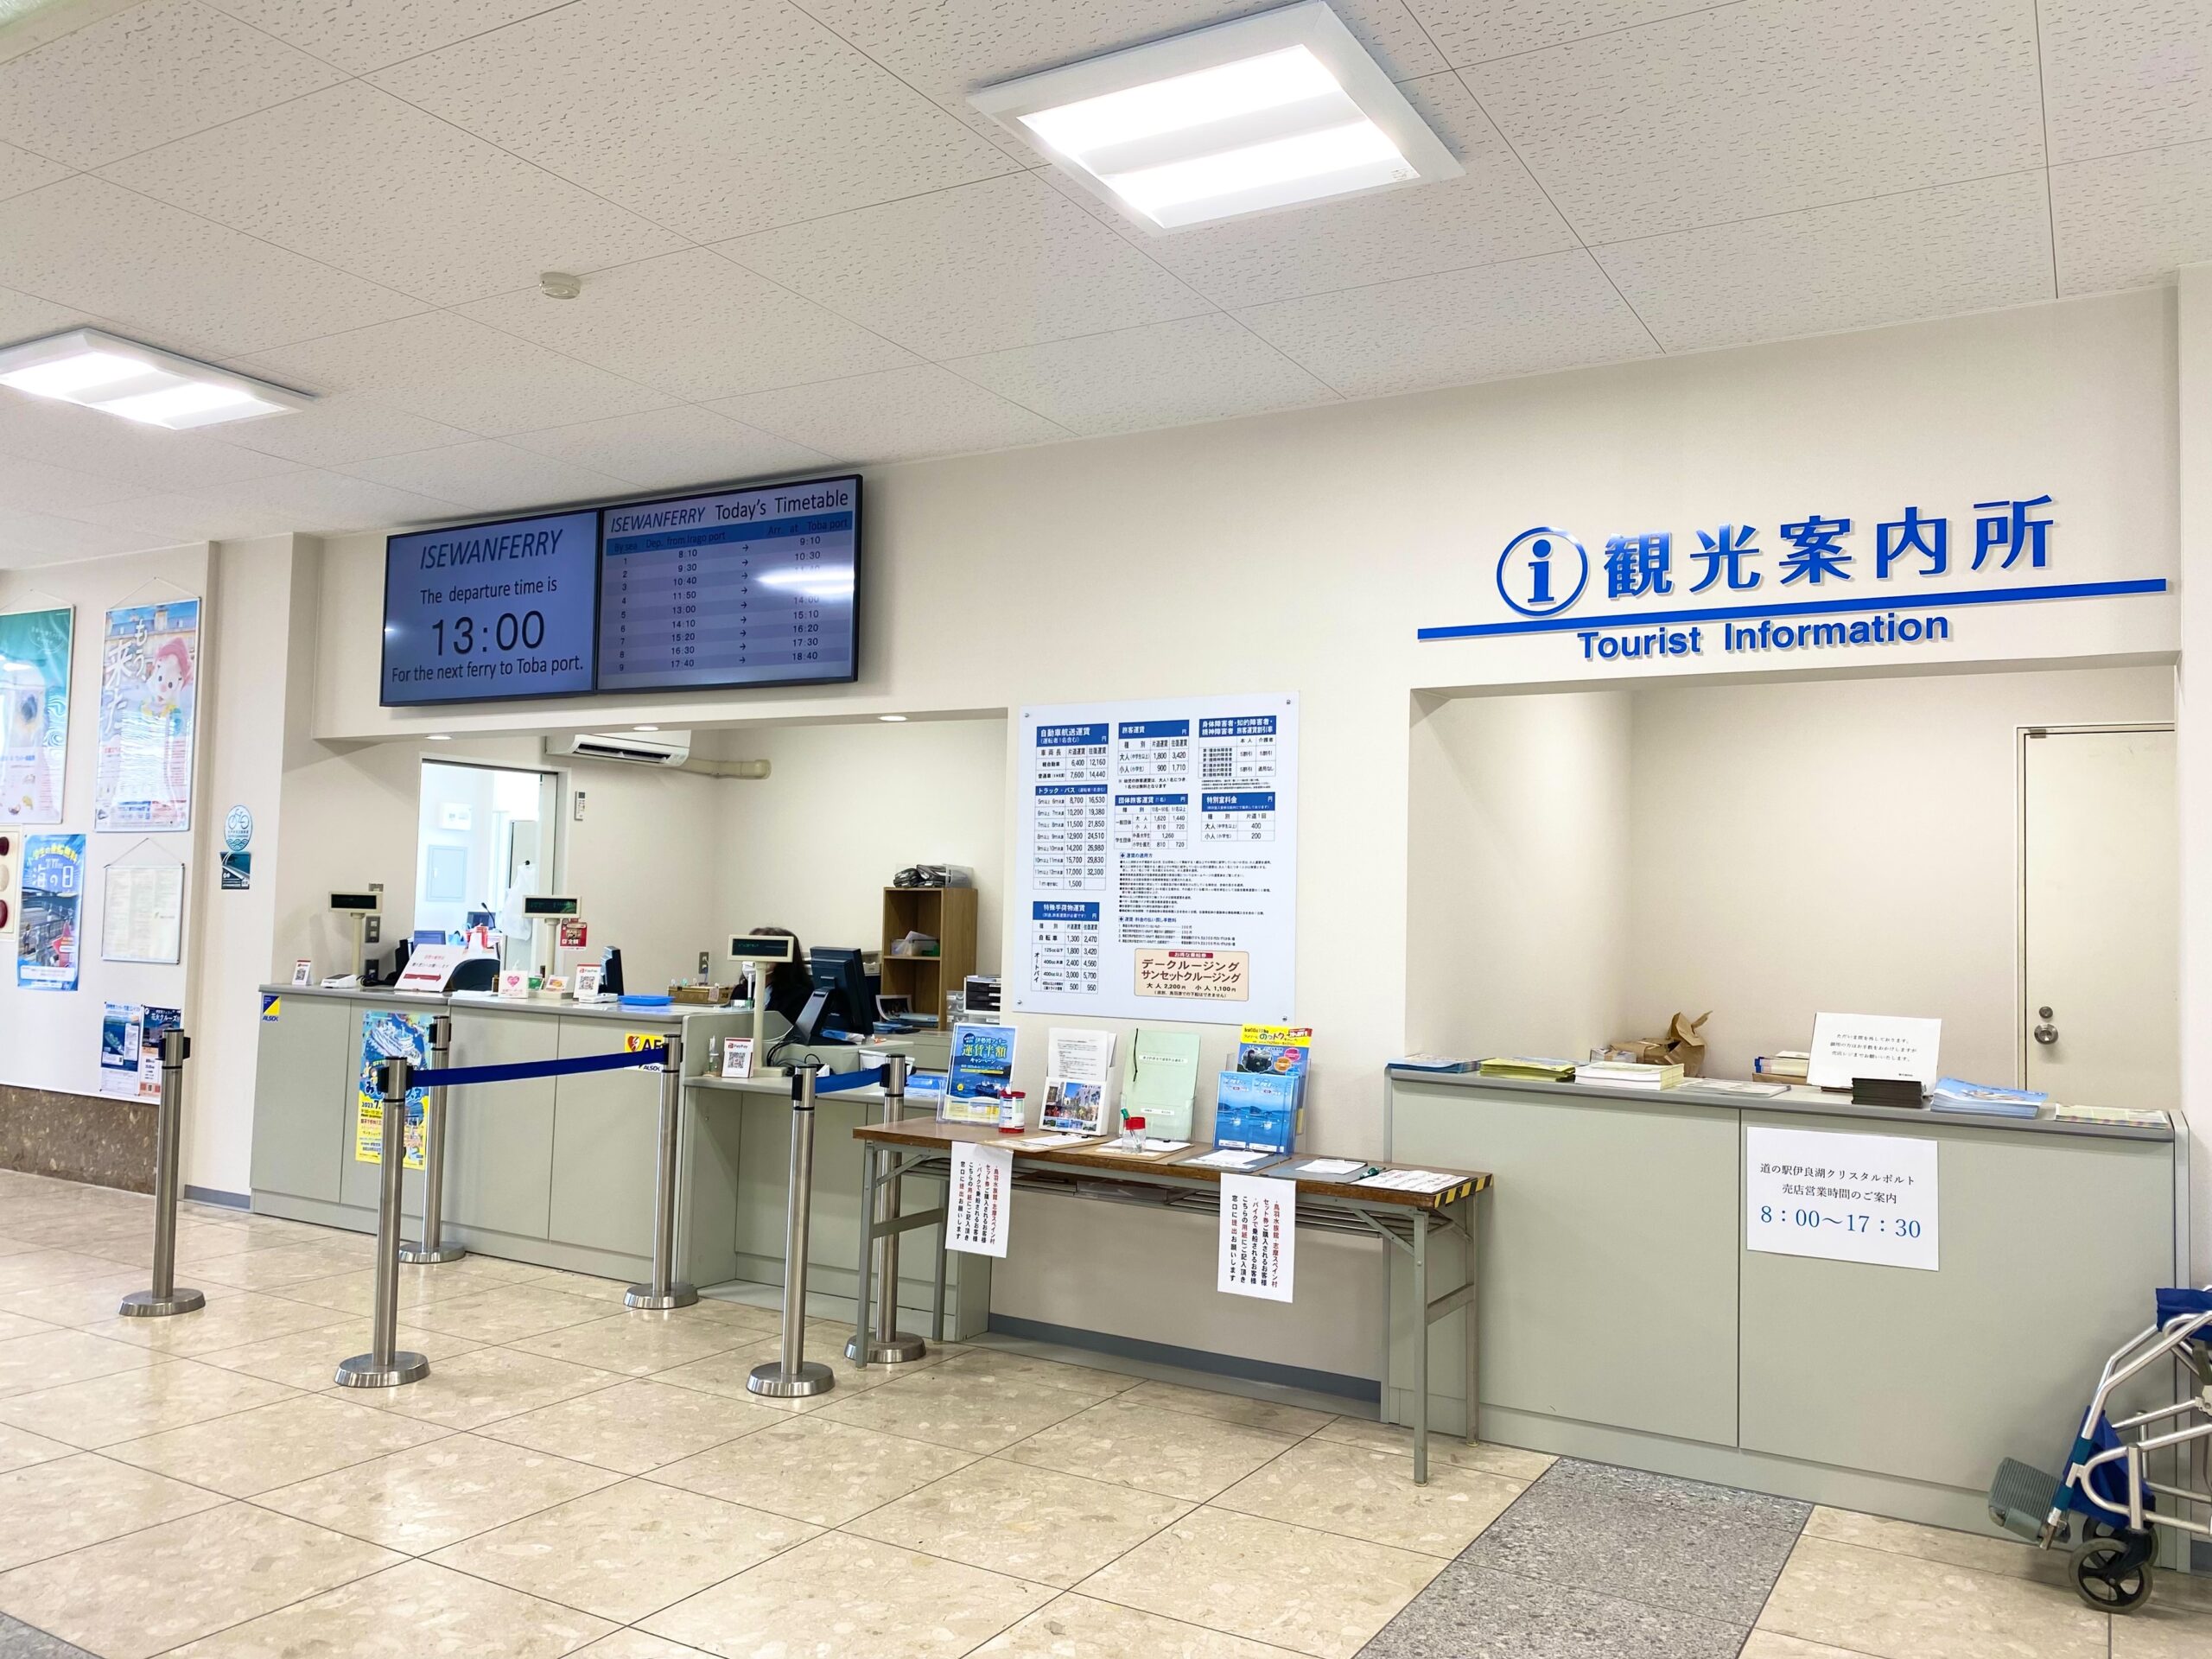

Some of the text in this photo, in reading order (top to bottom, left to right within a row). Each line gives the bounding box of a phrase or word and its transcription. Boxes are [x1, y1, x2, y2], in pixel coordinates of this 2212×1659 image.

[611, 506, 706, 533] ISEWANFERRY
[775, 489, 849, 514] Timetable
[807, 520, 828, 531] Toba
[830, 518, 848, 531] port
[666, 534, 685, 546] from
[709, 531, 726, 543] port
[800, 537, 821, 546] 9:10
[420, 529, 563, 569] ISEWANFERRY
[1604, 494, 2055, 600] 観光案内所
[795, 551, 821, 561] 10:30
[421, 575, 557, 605] The departure time is
[793, 610, 819, 619] 15:10
[432, 610, 544, 657] 13:00
[793, 624, 819, 632] 16:20
[793, 638, 818, 647] 17:30
[1578, 611, 1950, 661] Tourist Information
[792, 652, 817, 660] 18:40
[391, 655, 583, 683] For the next ferry to Toba port.
[1040, 727, 1090, 737] 自動車航送運賃
[32, 864, 74, 888] 海の日
[1142, 959, 1240, 972] デークルージング
[1141, 970, 1241, 983] サンセットクルージング
[642, 1039, 663, 1050] AE
[962, 1044, 1007, 1058] 運賃半額
[1782, 1184, 1897, 1205] 売店営業時間のご案内
